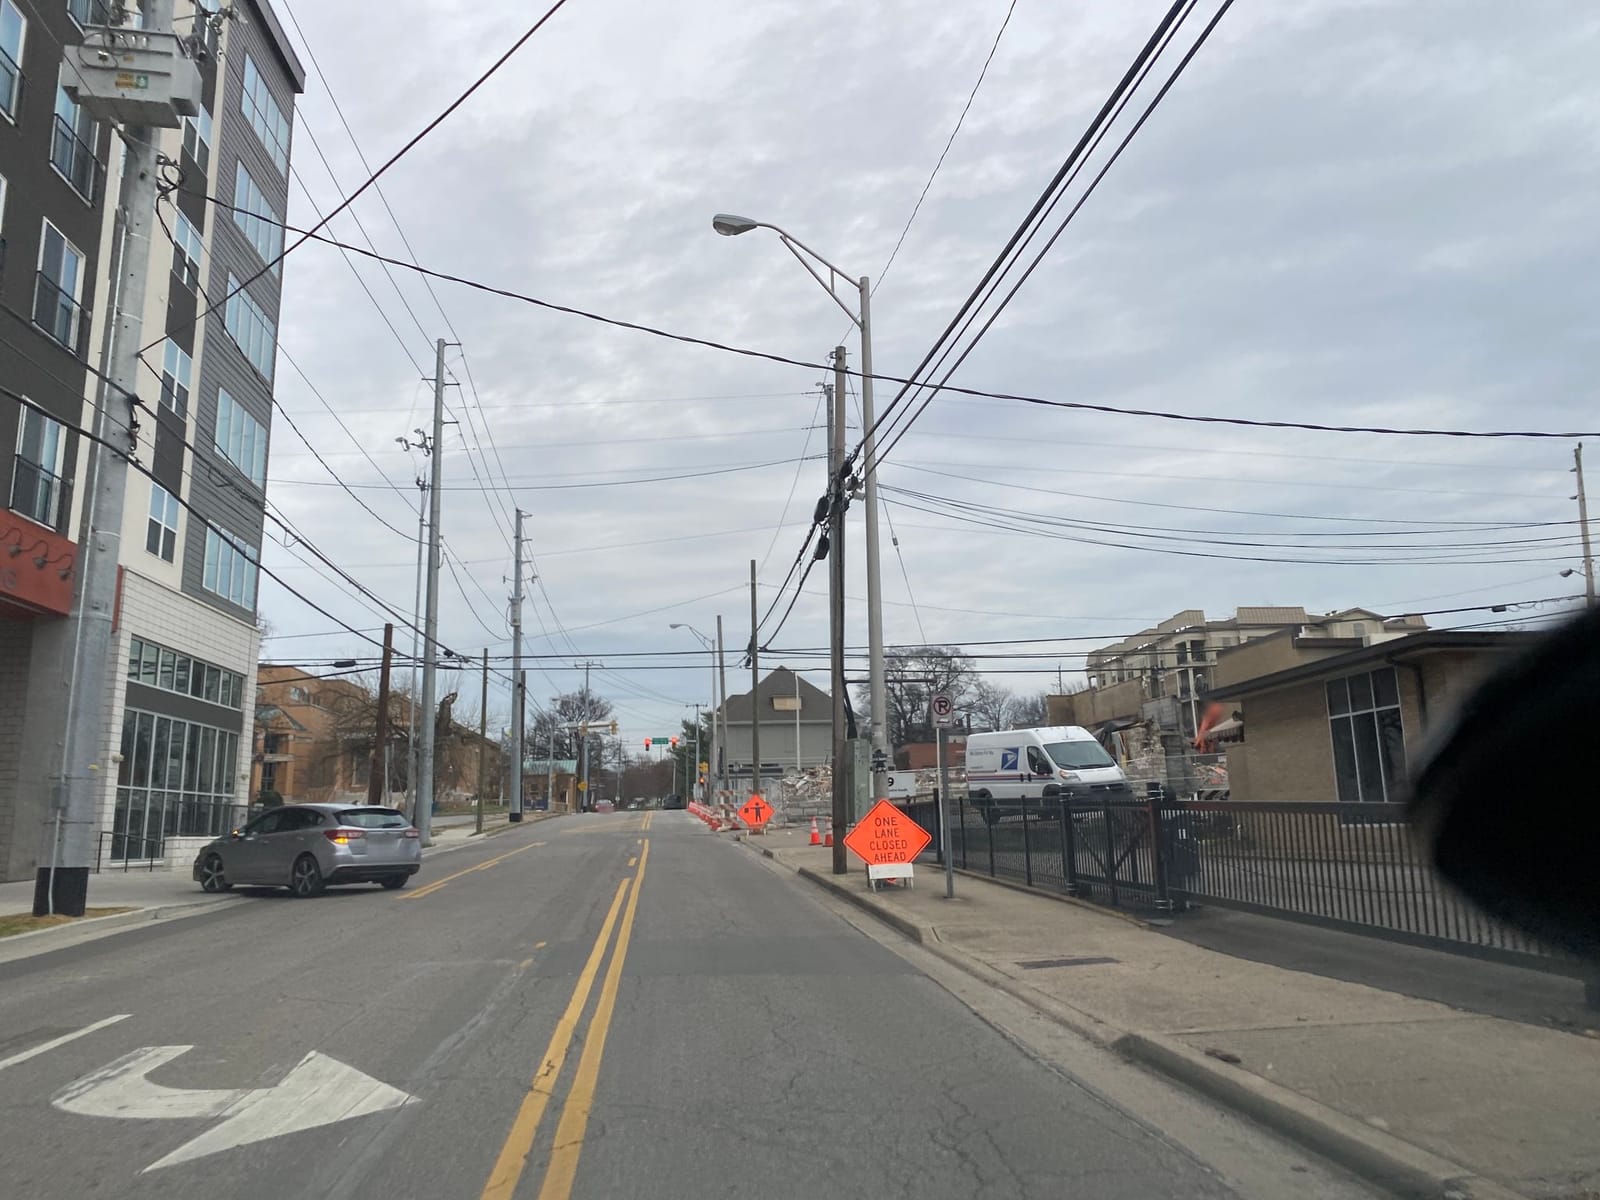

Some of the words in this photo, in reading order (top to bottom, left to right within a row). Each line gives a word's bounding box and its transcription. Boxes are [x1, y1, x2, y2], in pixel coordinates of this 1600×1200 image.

[874, 816, 898, 827] ONE
[874, 828, 900, 838] LANE
[869, 840, 908, 851] CLOSED
[874, 851, 906, 862] AHEAD
